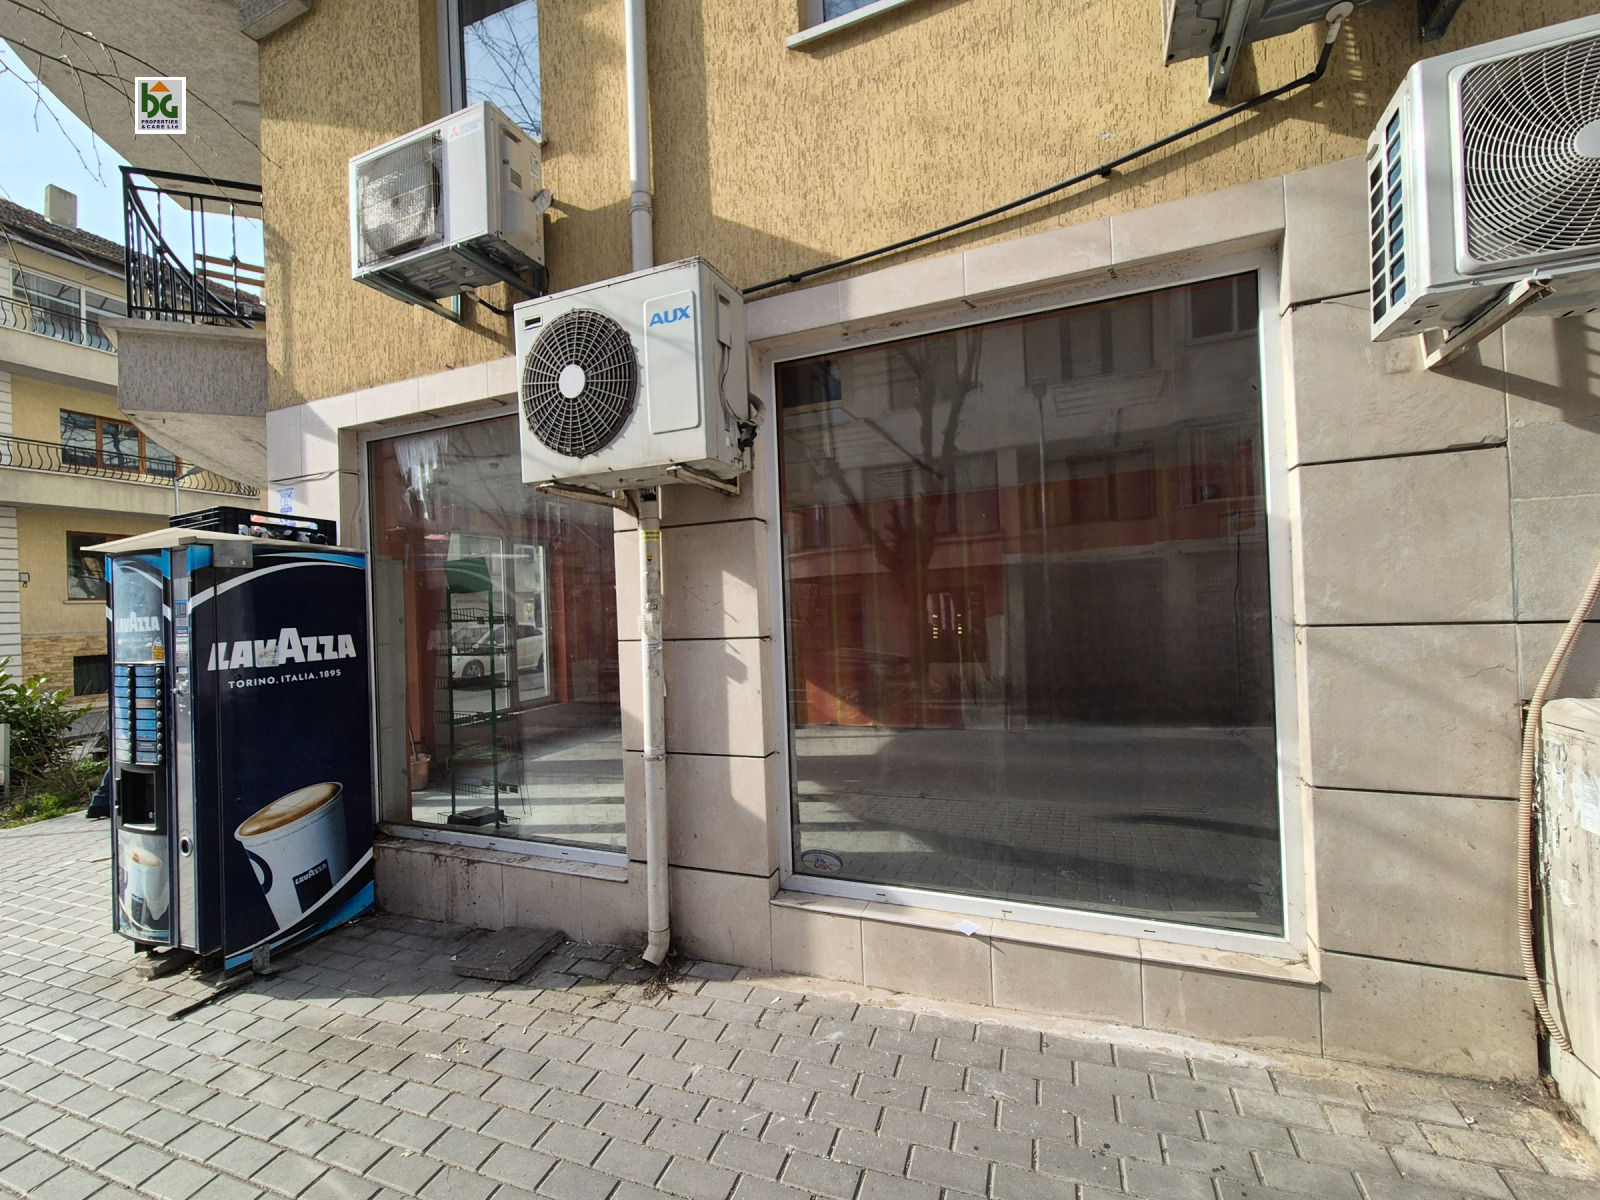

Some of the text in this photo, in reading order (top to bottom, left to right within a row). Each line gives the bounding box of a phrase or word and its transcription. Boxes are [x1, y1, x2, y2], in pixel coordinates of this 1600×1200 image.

[649, 305, 690, 327] AUX
[207, 627, 357, 671] LAVAZZA
[319, 669, 341, 678] 1895
